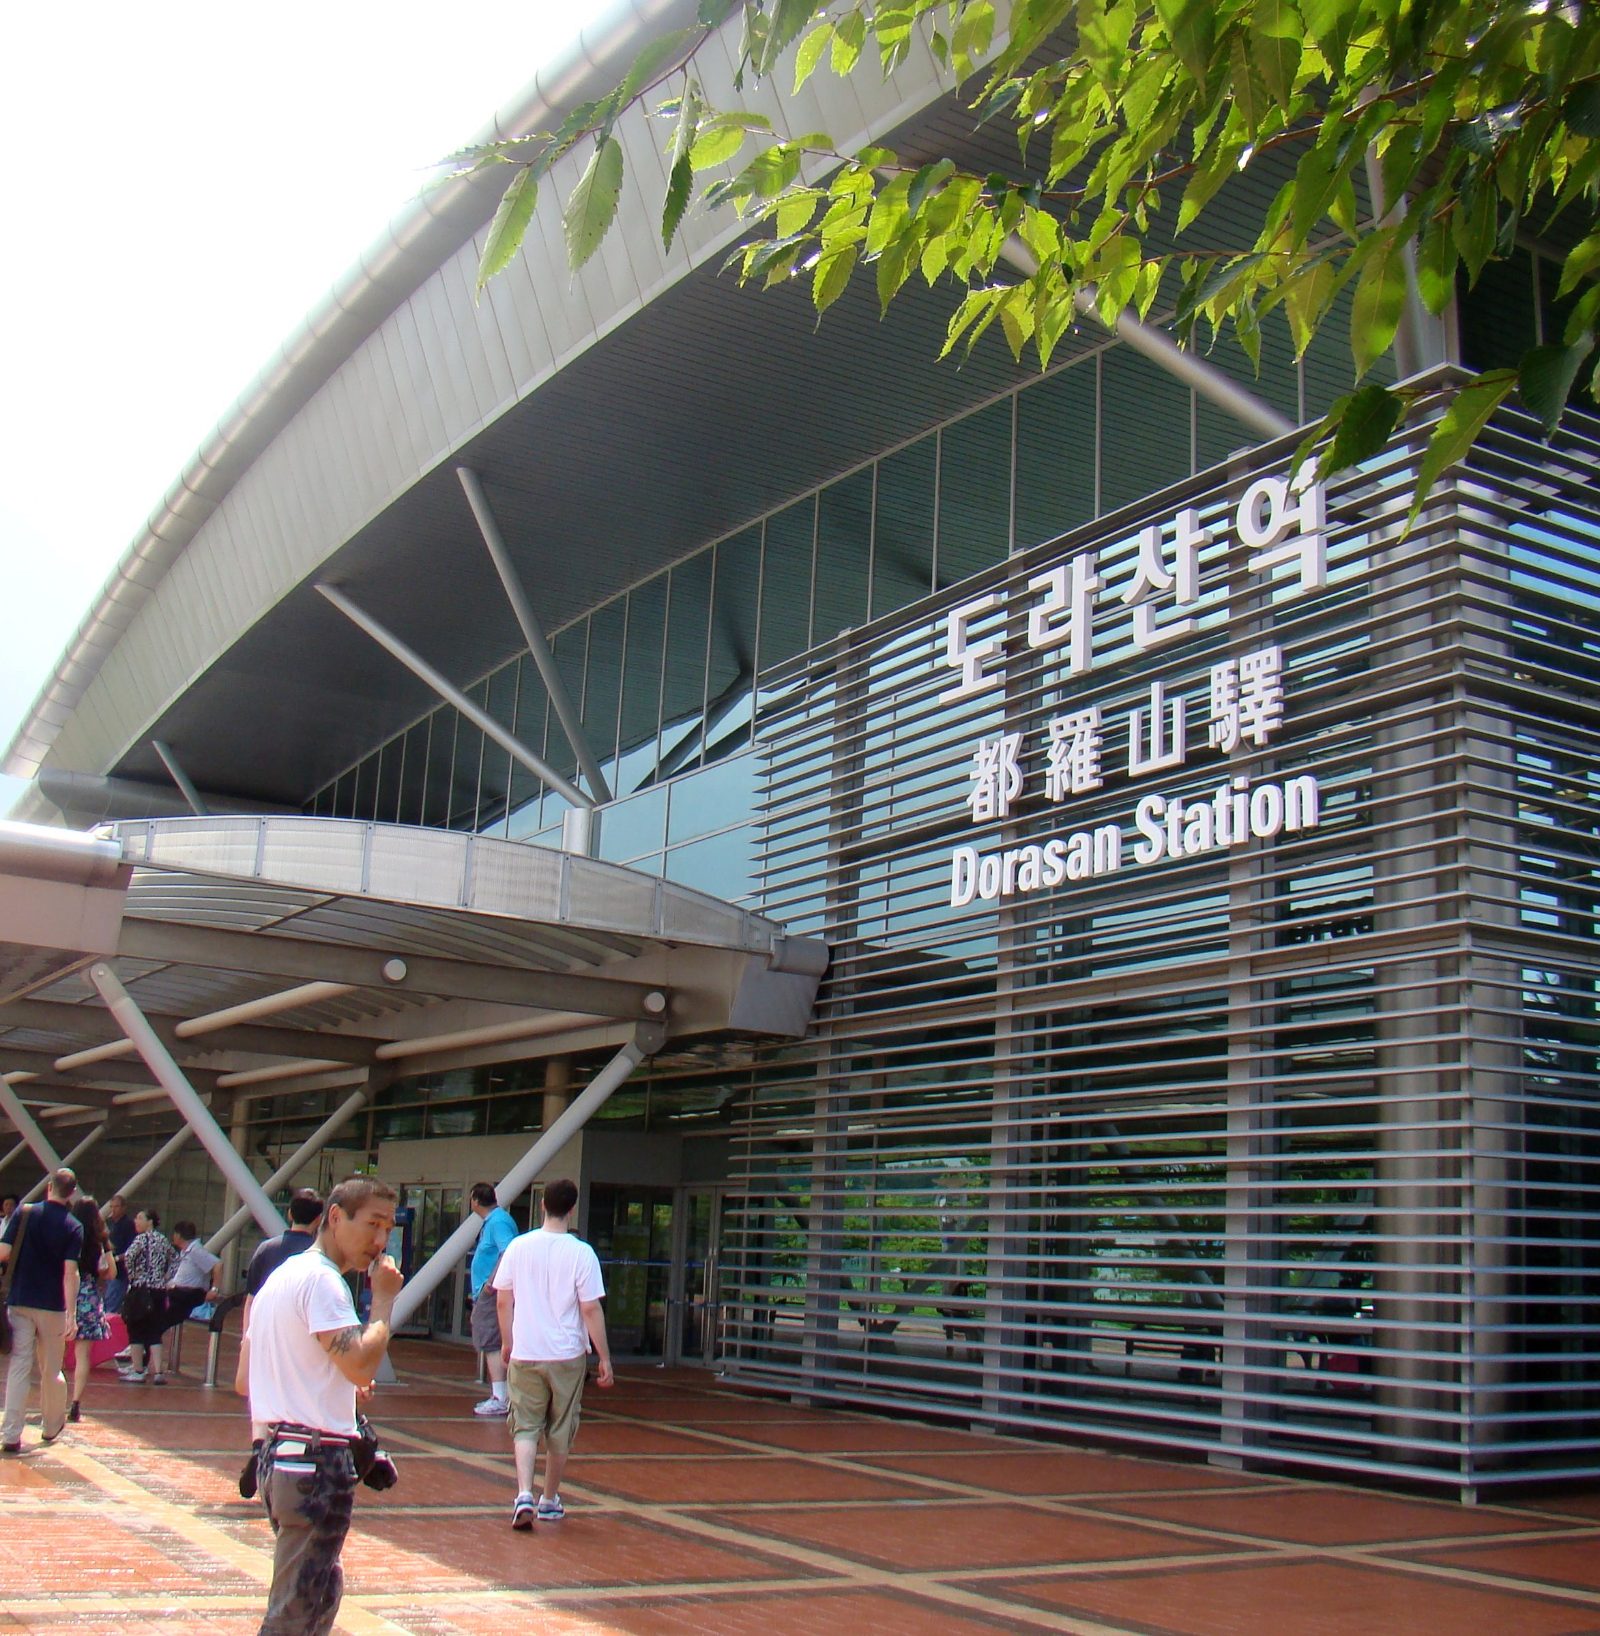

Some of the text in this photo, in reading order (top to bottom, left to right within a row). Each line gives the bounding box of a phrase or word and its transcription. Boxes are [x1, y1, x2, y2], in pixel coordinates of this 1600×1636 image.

[938, 456, 1327, 705] 도라산역
[966, 645, 1284, 823] 都羅山驛
[951, 775, 1319, 907] Dorasan Station
